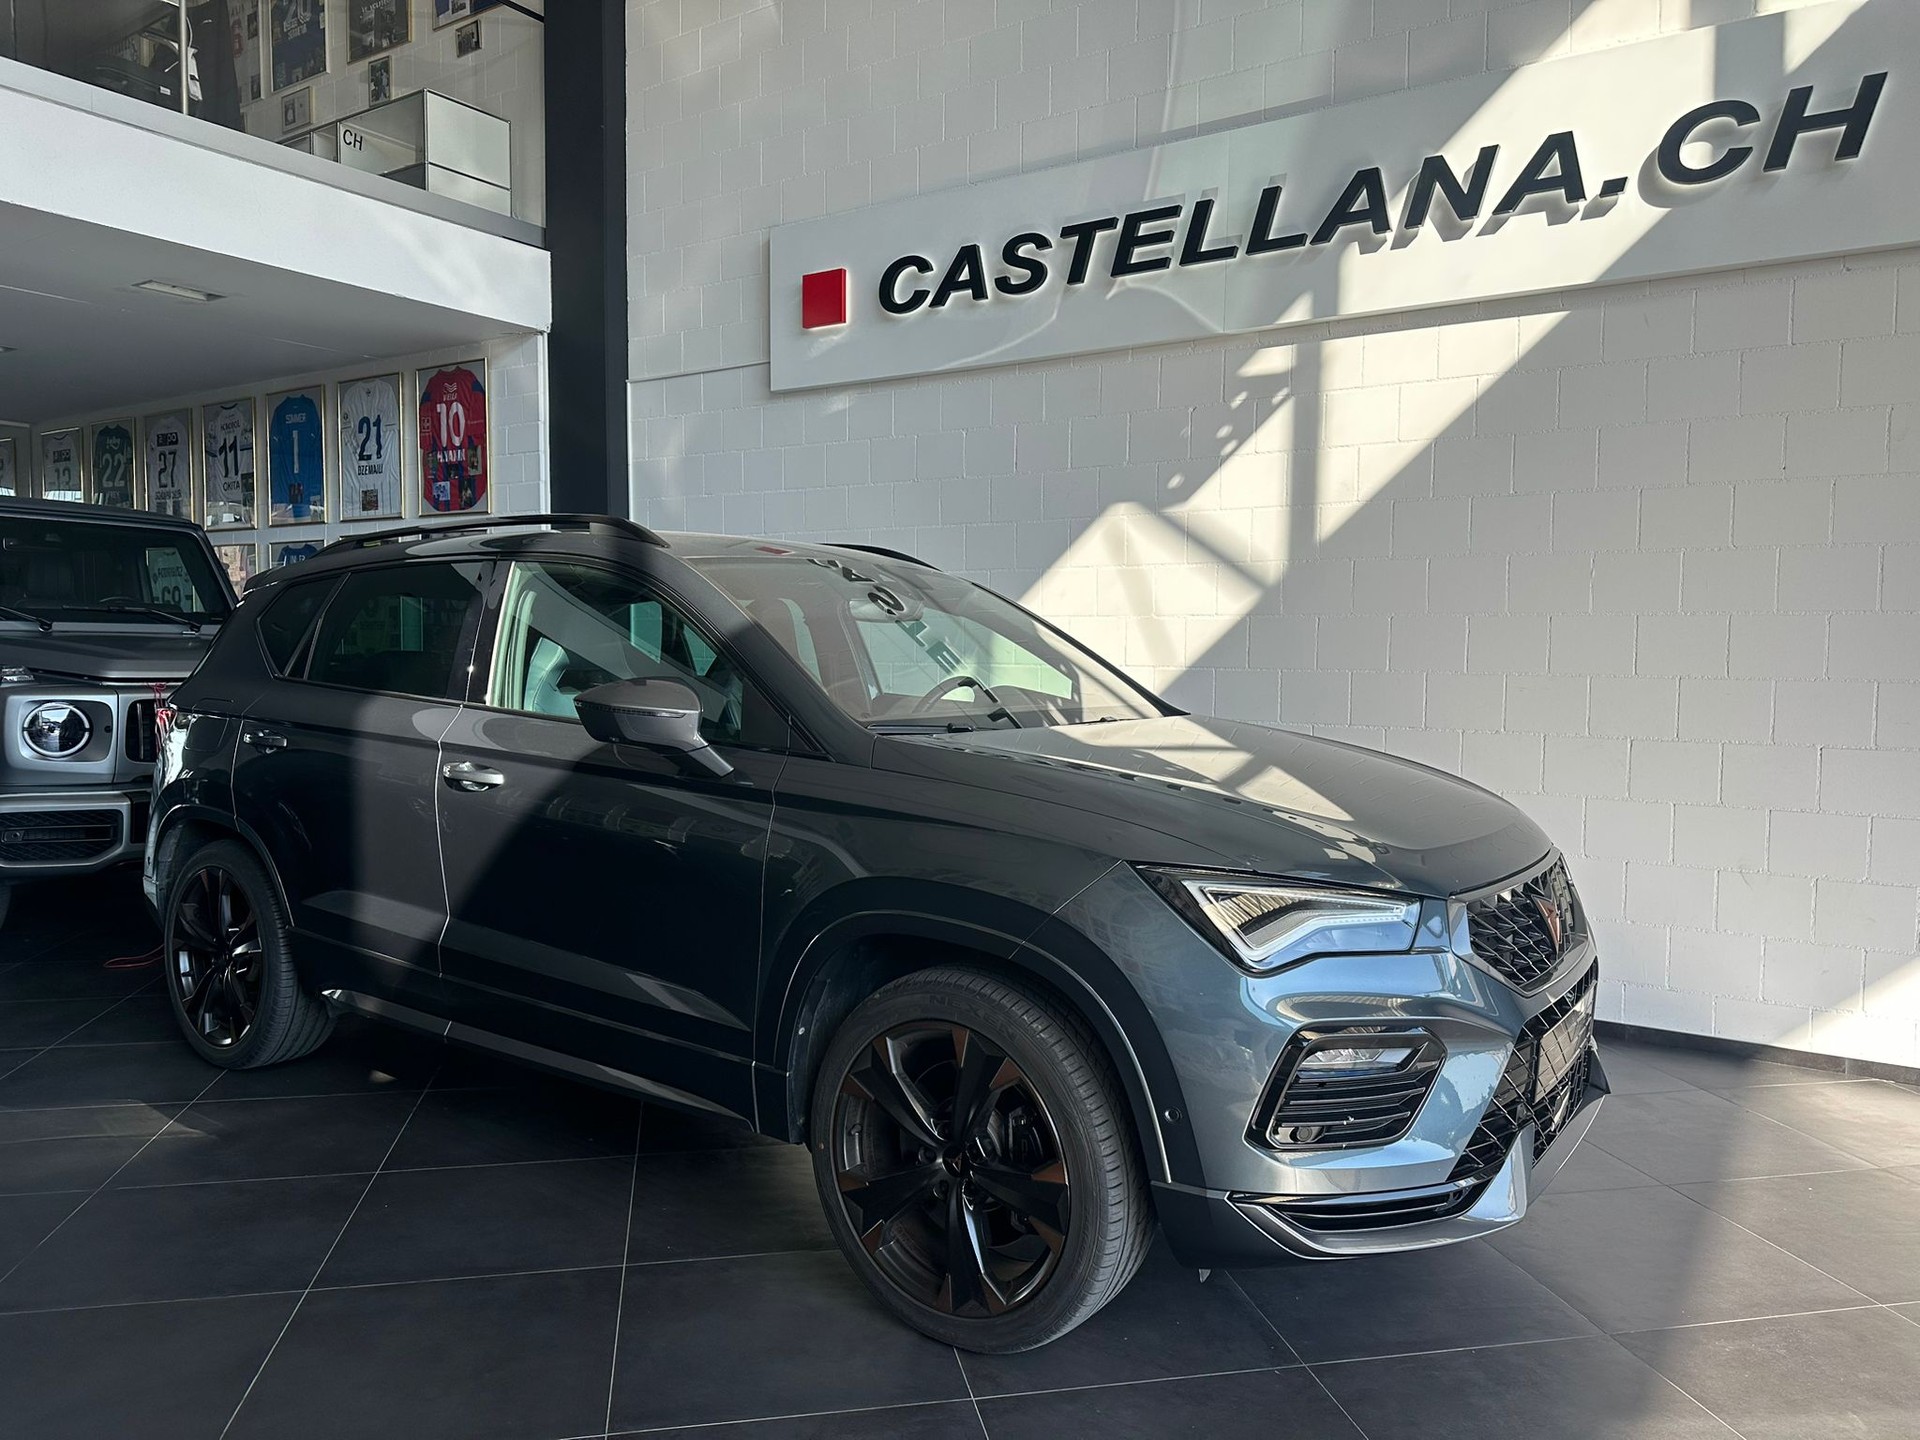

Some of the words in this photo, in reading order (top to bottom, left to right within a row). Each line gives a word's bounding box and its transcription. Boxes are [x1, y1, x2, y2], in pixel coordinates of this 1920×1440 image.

[342, 128, 364, 152] CH
[878, 71, 1889, 315] CASTELLANA.CH
[358, 414, 383, 462] 21
[437, 401, 466, 448] 10
[102, 452, 125, 488] 22
[158, 450, 178, 488] 27
[218, 435, 239, 478] 11
[292, 430, 300, 474] 1
[222, 480, 241, 492] OKITA
